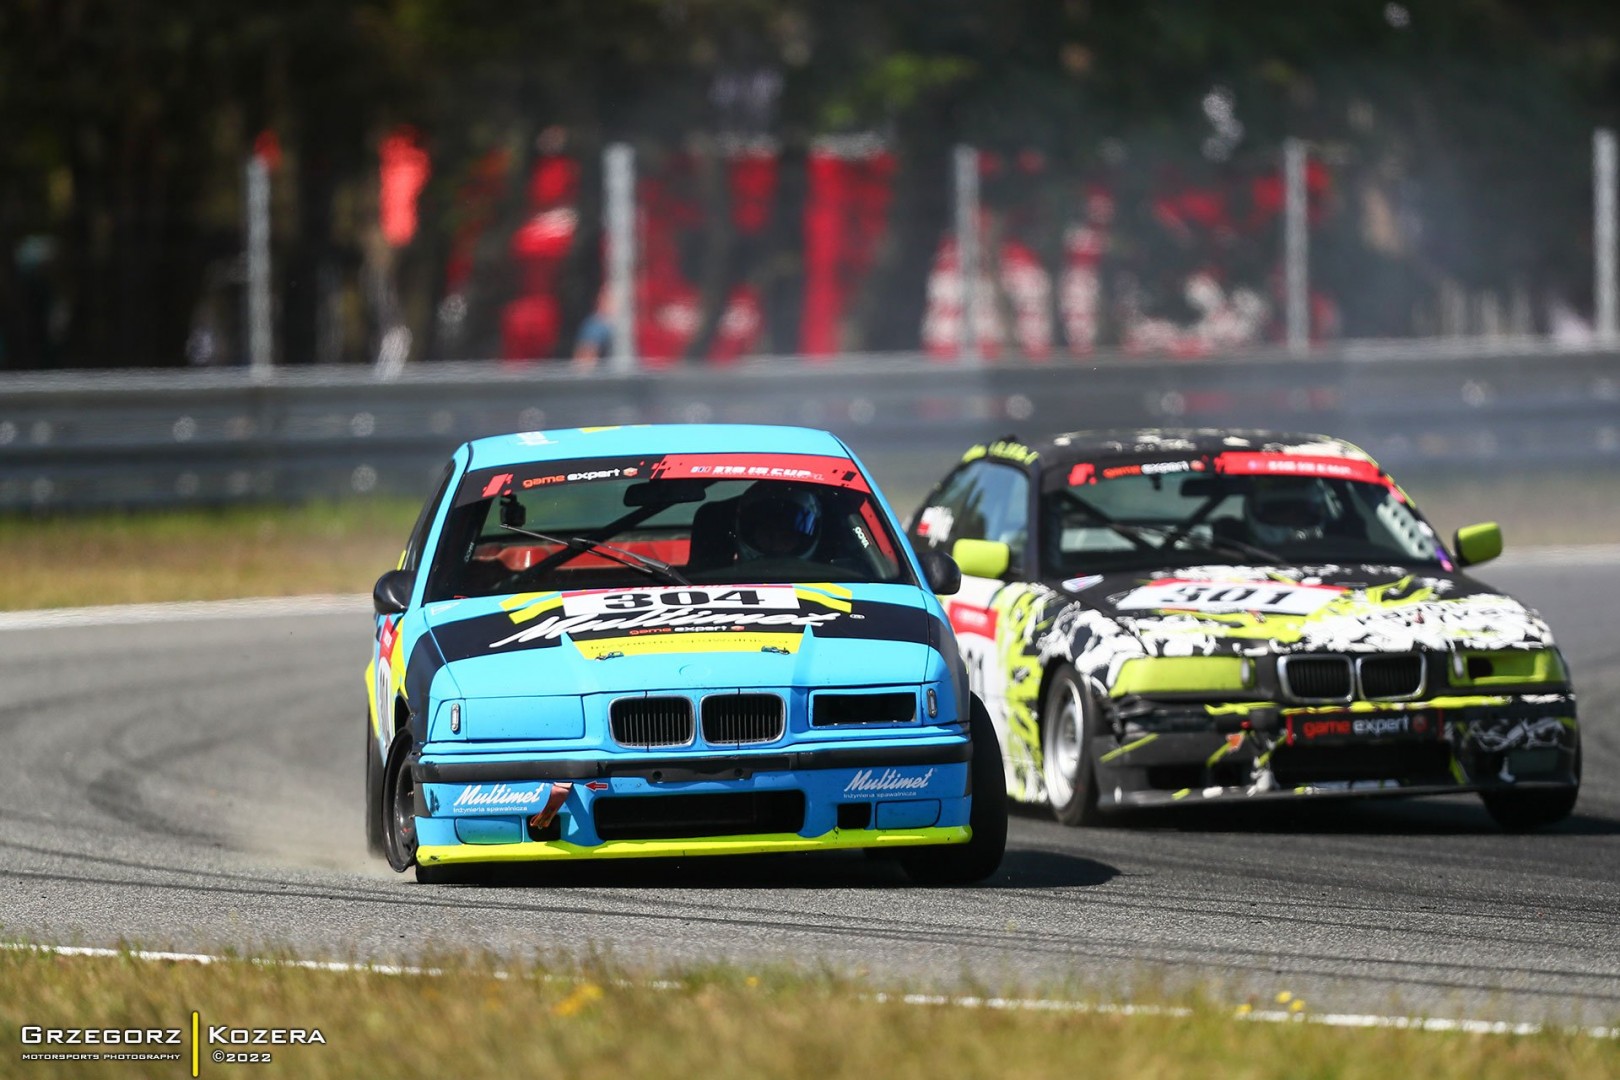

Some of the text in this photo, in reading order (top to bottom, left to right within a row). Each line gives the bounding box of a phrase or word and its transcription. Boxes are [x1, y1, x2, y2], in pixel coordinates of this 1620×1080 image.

[522, 468, 621, 489] game expert
[770, 467, 812, 479] CUP
[1103, 460, 1190, 479] game expert
[603, 589, 765, 610] 304
[674, 624, 727, 633] expert
[1303, 714, 1410, 740] game expert
[843, 767, 934, 792] Multimet
[453, 782, 545, 807] Multimet
